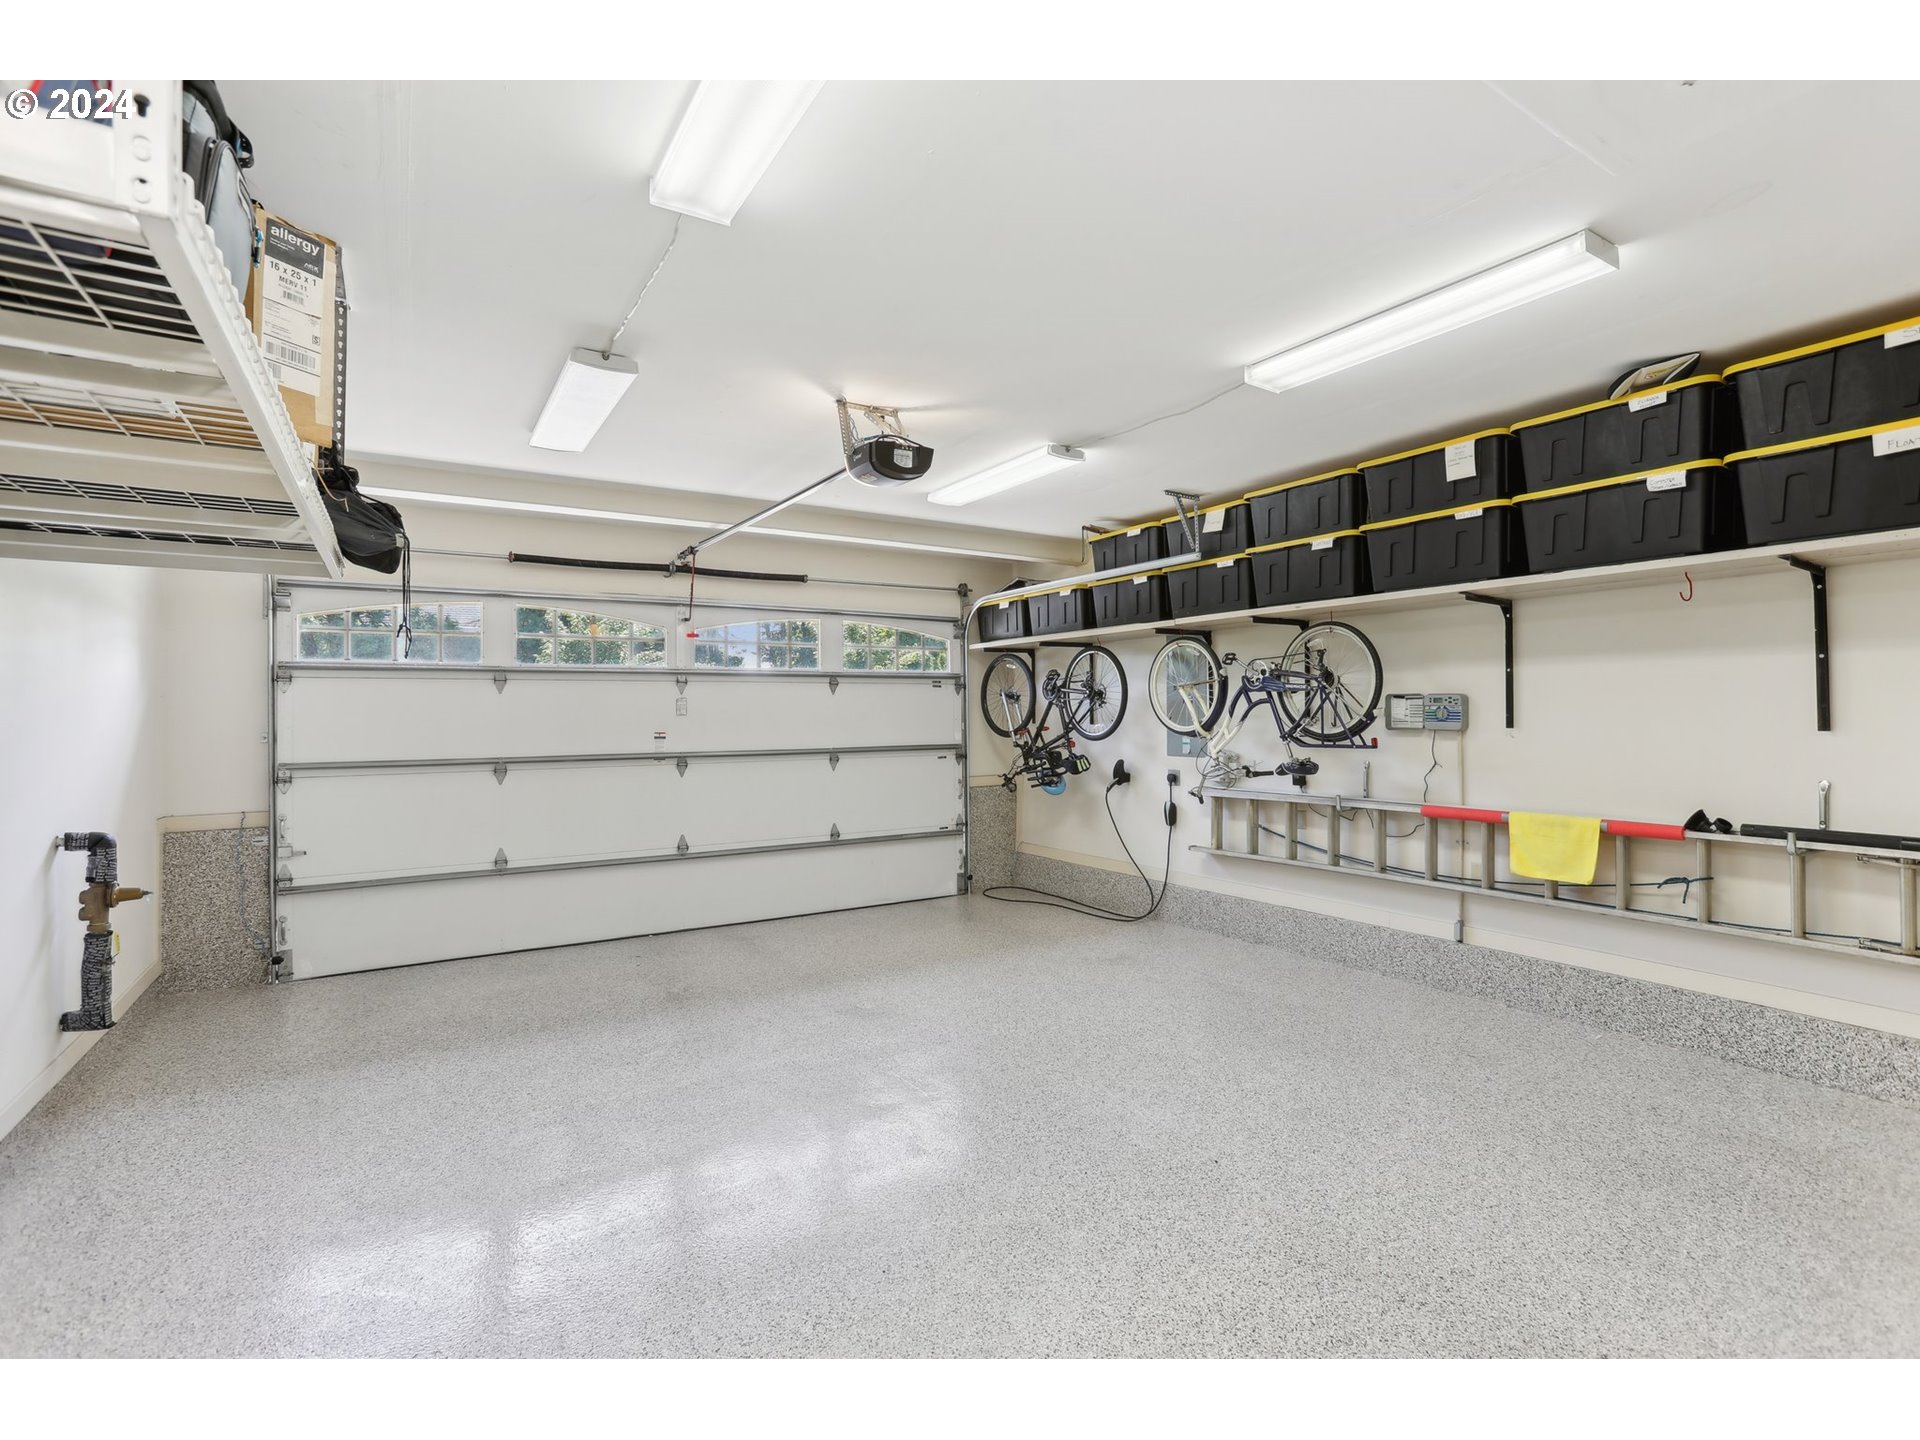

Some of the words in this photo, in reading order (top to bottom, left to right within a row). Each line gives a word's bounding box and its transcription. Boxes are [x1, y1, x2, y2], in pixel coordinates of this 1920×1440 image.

[270, 226, 320, 256] allergy
[270, 261, 280, 271] 16
[290, 269, 301, 280] 25
[279, 276, 298, 288] MERV
